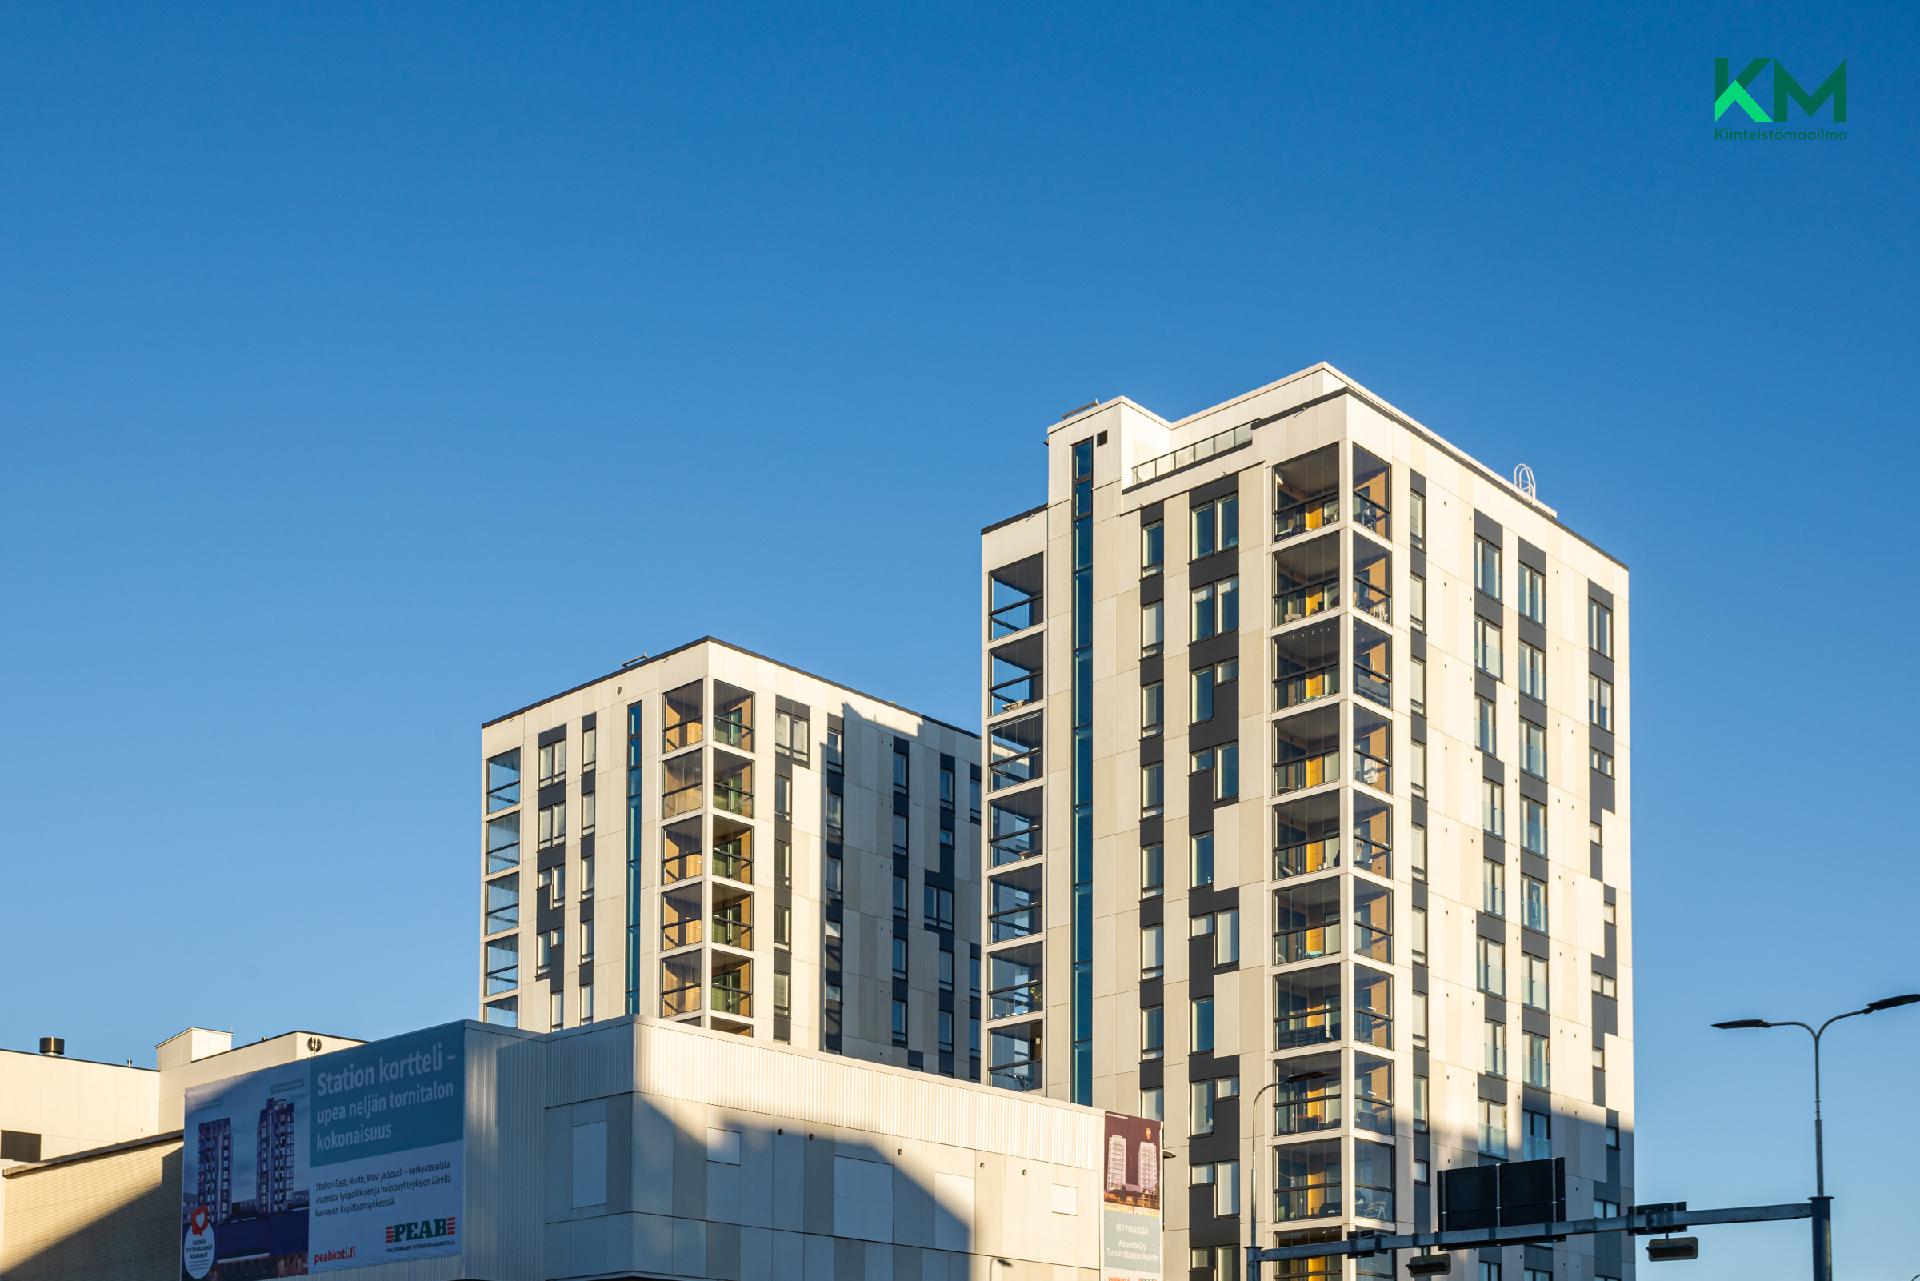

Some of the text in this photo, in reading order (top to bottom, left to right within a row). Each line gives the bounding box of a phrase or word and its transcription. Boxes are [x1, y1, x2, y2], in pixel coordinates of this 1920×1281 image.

[317, 1063, 375, 1096] Station
[379, 1042, 443, 1083] kortteli
[316, 1080, 454, 1127] upea neljän tornitalon
[316, 1123, 392, 1151] kokonaisuus
[393, 1218, 447, 1243] PEAB
